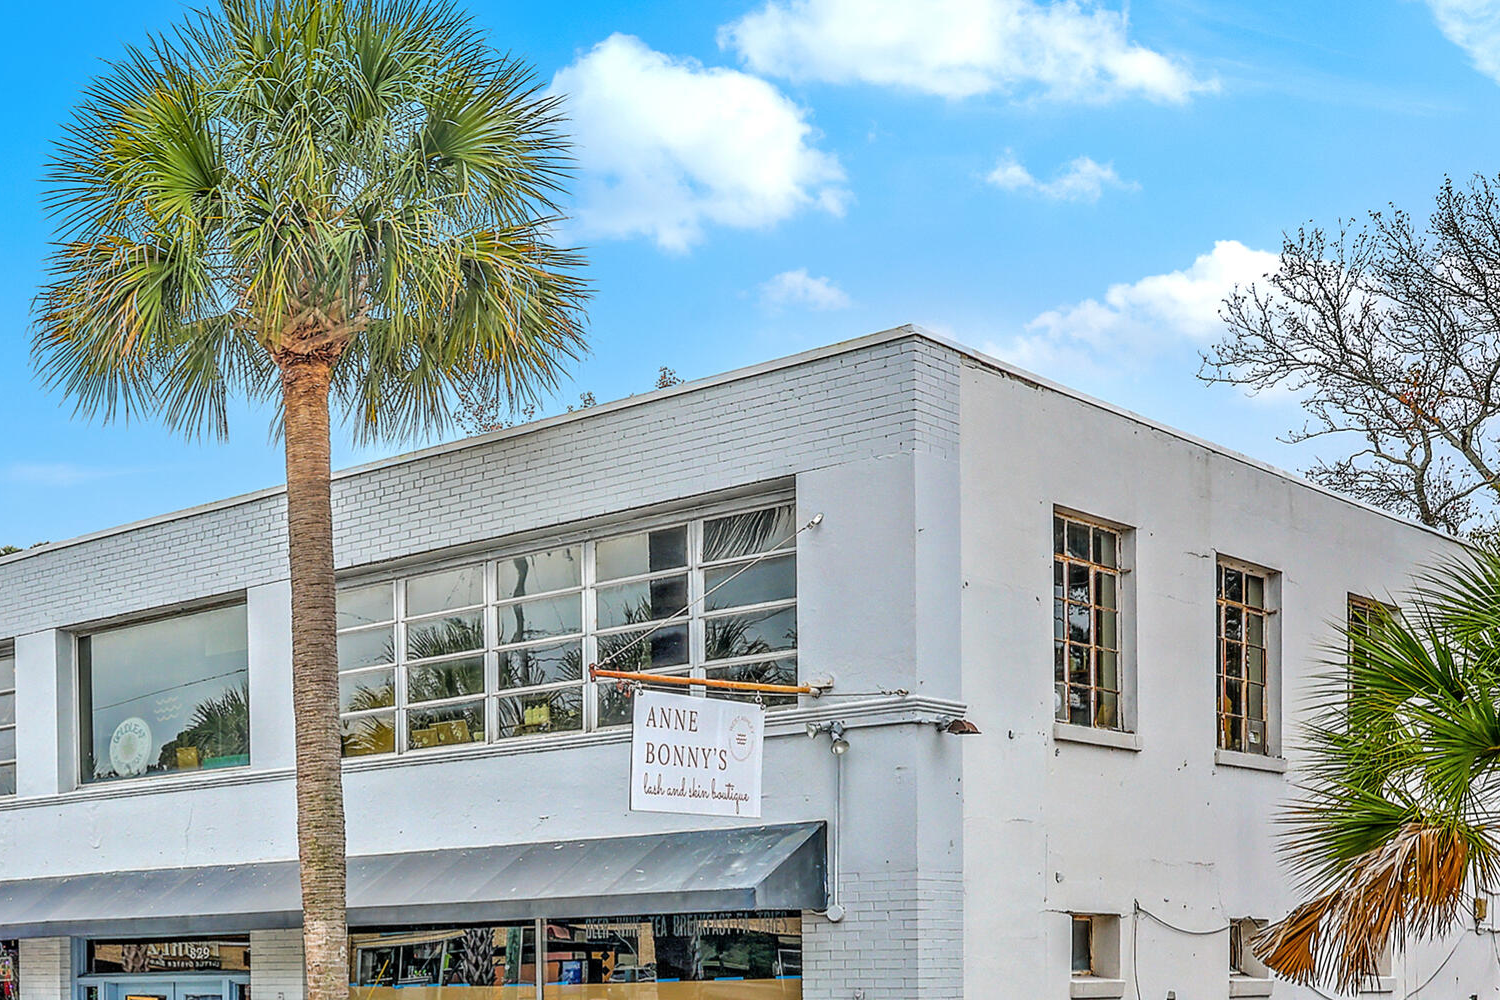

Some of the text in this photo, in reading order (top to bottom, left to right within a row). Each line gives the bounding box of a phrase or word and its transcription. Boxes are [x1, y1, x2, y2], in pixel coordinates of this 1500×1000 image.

[645, 705, 698, 732] ANNE
[645, 741, 728, 771] BONNY'S
[643, 772, 749, 815] lash and skin boutique
[189, 946, 210, 960] 829
